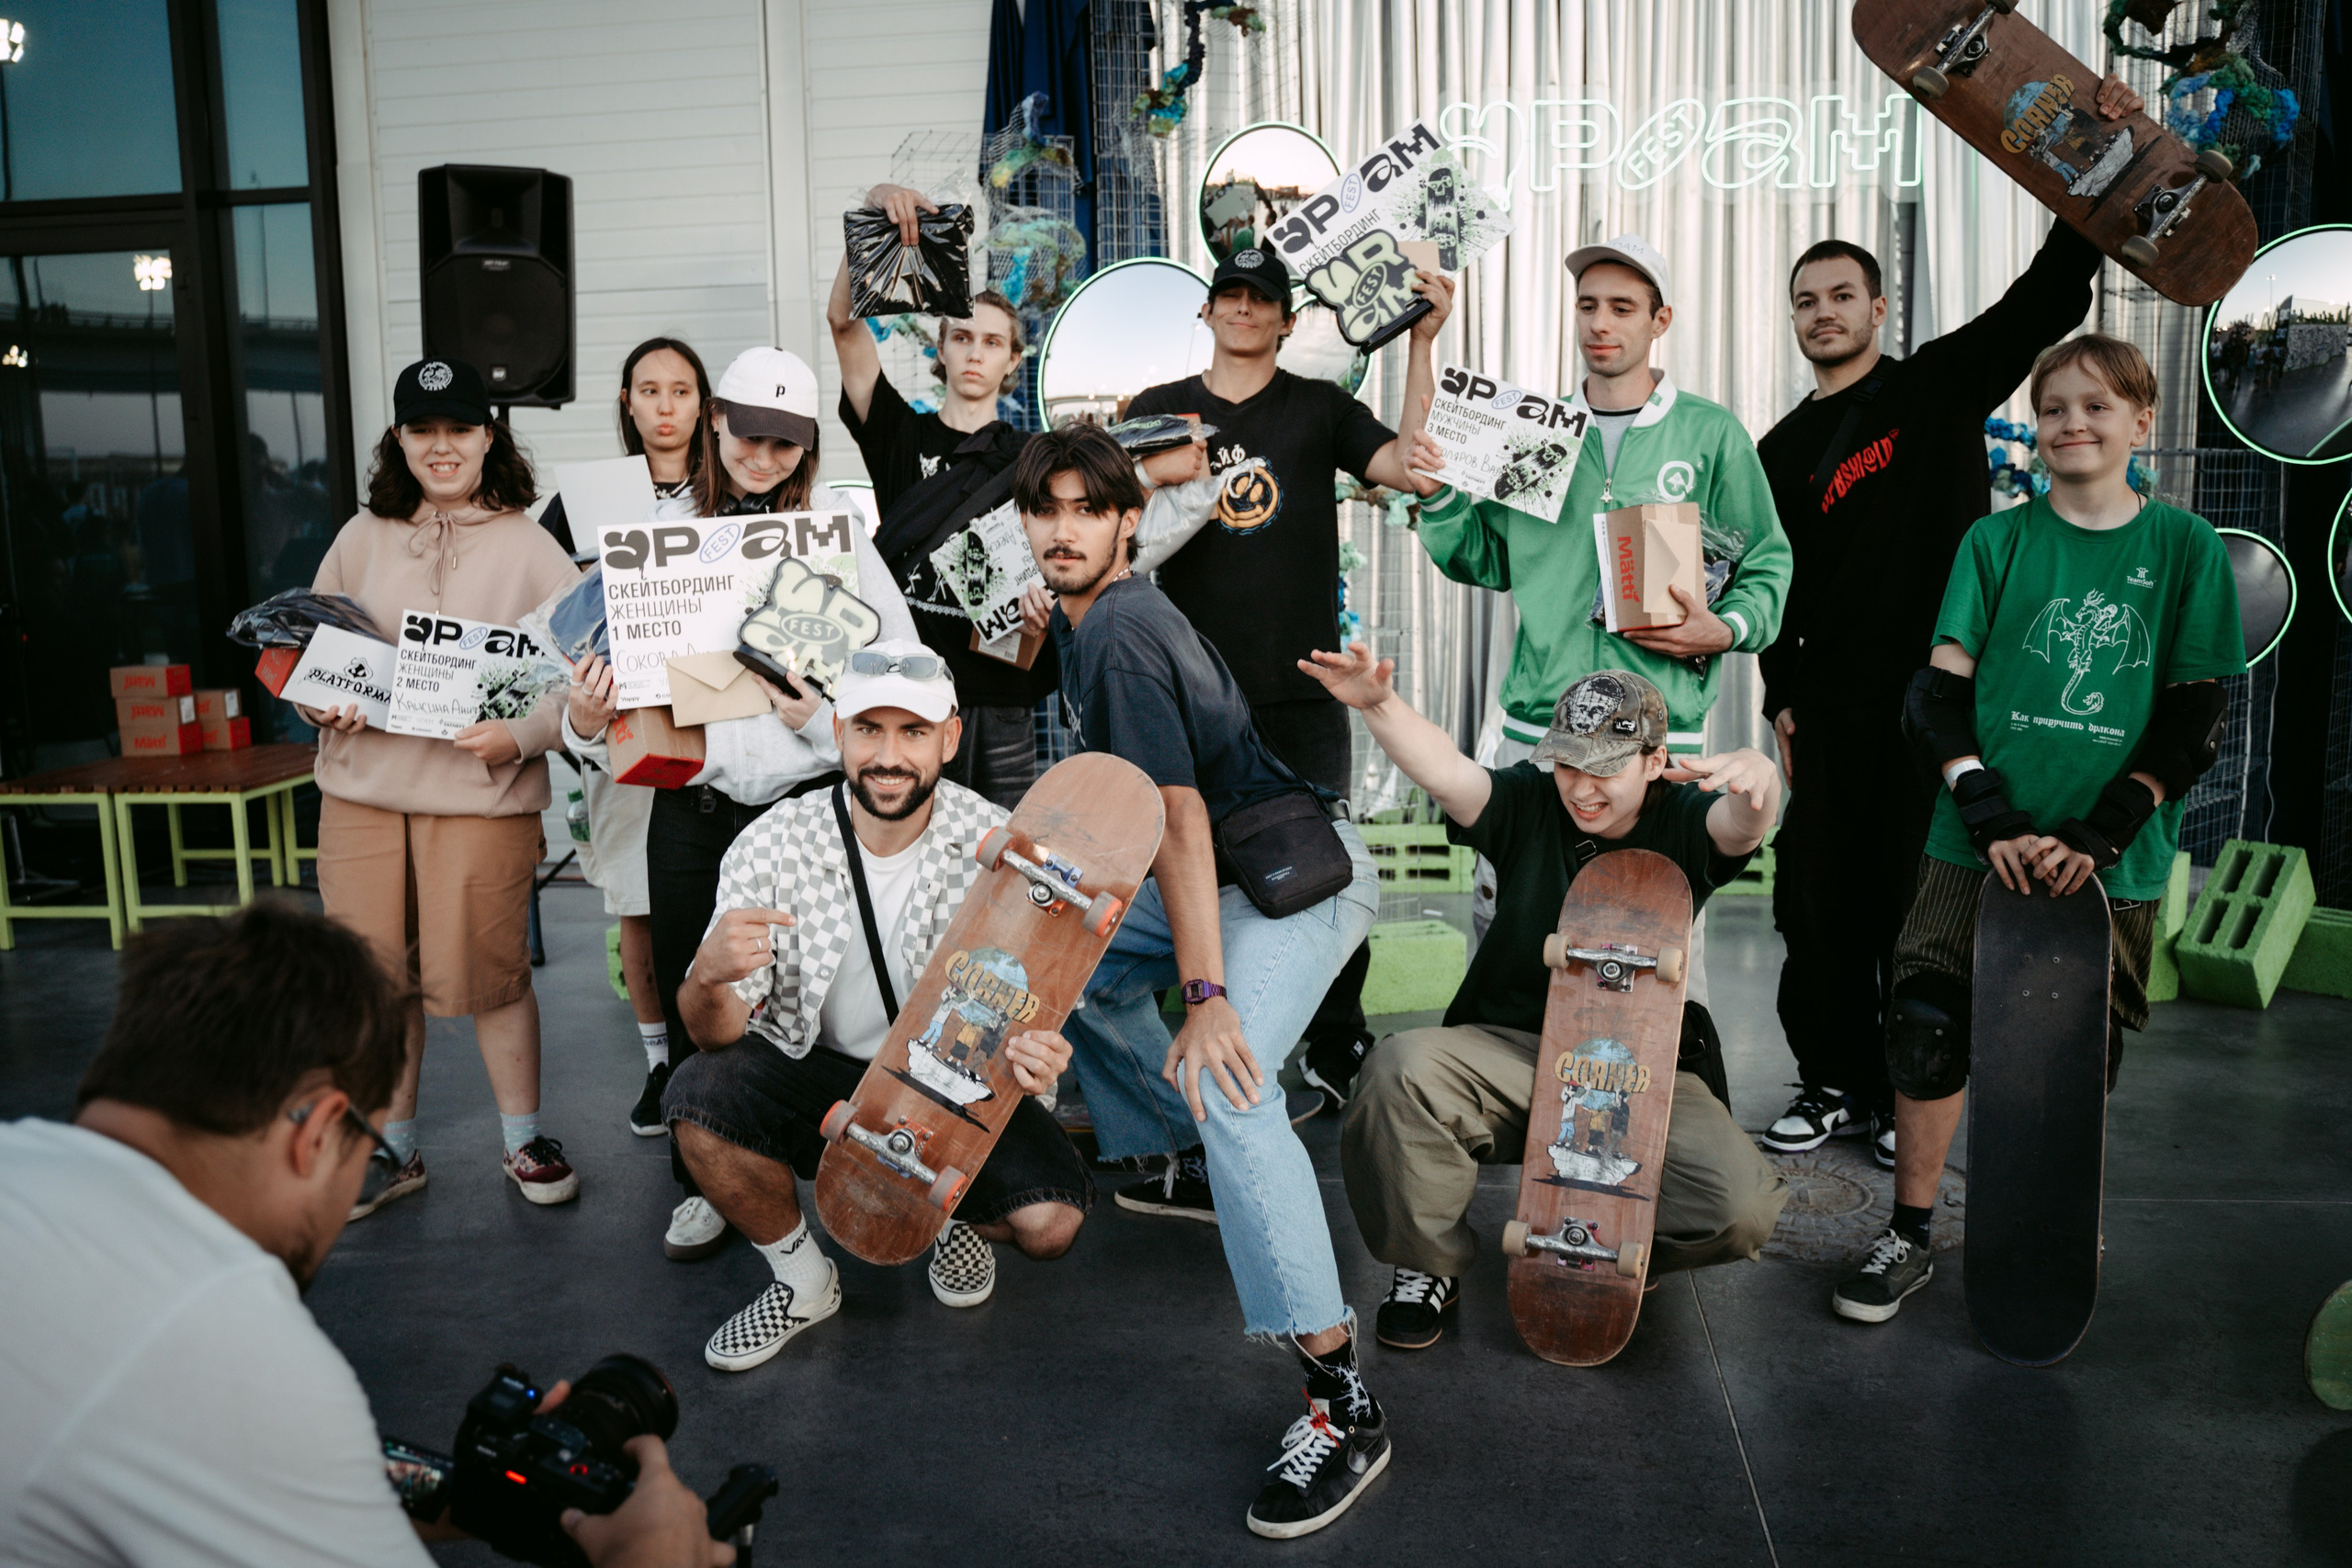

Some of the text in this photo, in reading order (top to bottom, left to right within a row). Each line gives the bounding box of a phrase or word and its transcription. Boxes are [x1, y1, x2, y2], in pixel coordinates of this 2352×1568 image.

[2001, 74, 2075, 153] CORNER
[1626, 107, 1696, 180] FEST
[1344, 178, 1360, 209] FEST
[1356, 267, 1381, 303] FEST
[1495, 393, 1518, 407] FEST
[1430, 410, 1481, 436] МУЖЧИНЫ
[1434, 398, 1507, 431] СКЕЙТБОРДИНГ
[1427, 423, 1467, 445] 3 МЕСТО
[703, 527, 736, 561] FEST
[1617, 536, 1640, 603] Mätti
[2127, 575, 2154, 587] TeamSoft
[608, 575, 735, 600] СКЕЙТБОРДИНГ
[610, 598, 702, 620] ЖЕНЩИНЫ
[463, 629, 485, 649] FEST
[611, 620, 682, 641] 1 МЕСТО
[789, 622, 835, 638] FEST
[398, 661, 455, 682] ЖЕНЩИНЫ
[400, 649, 478, 670] СКЕЙТБОРДИНГ
[396, 678, 440, 693] 2 МЕСТО
[2010, 711, 2030, 722] Как
[2032, 716, 2085, 730] приручить
[2087, 722, 2125, 737] дракона
[945, 950, 1040, 1024] CORNER
[1555, 1051, 1651, 1093] CORNER
